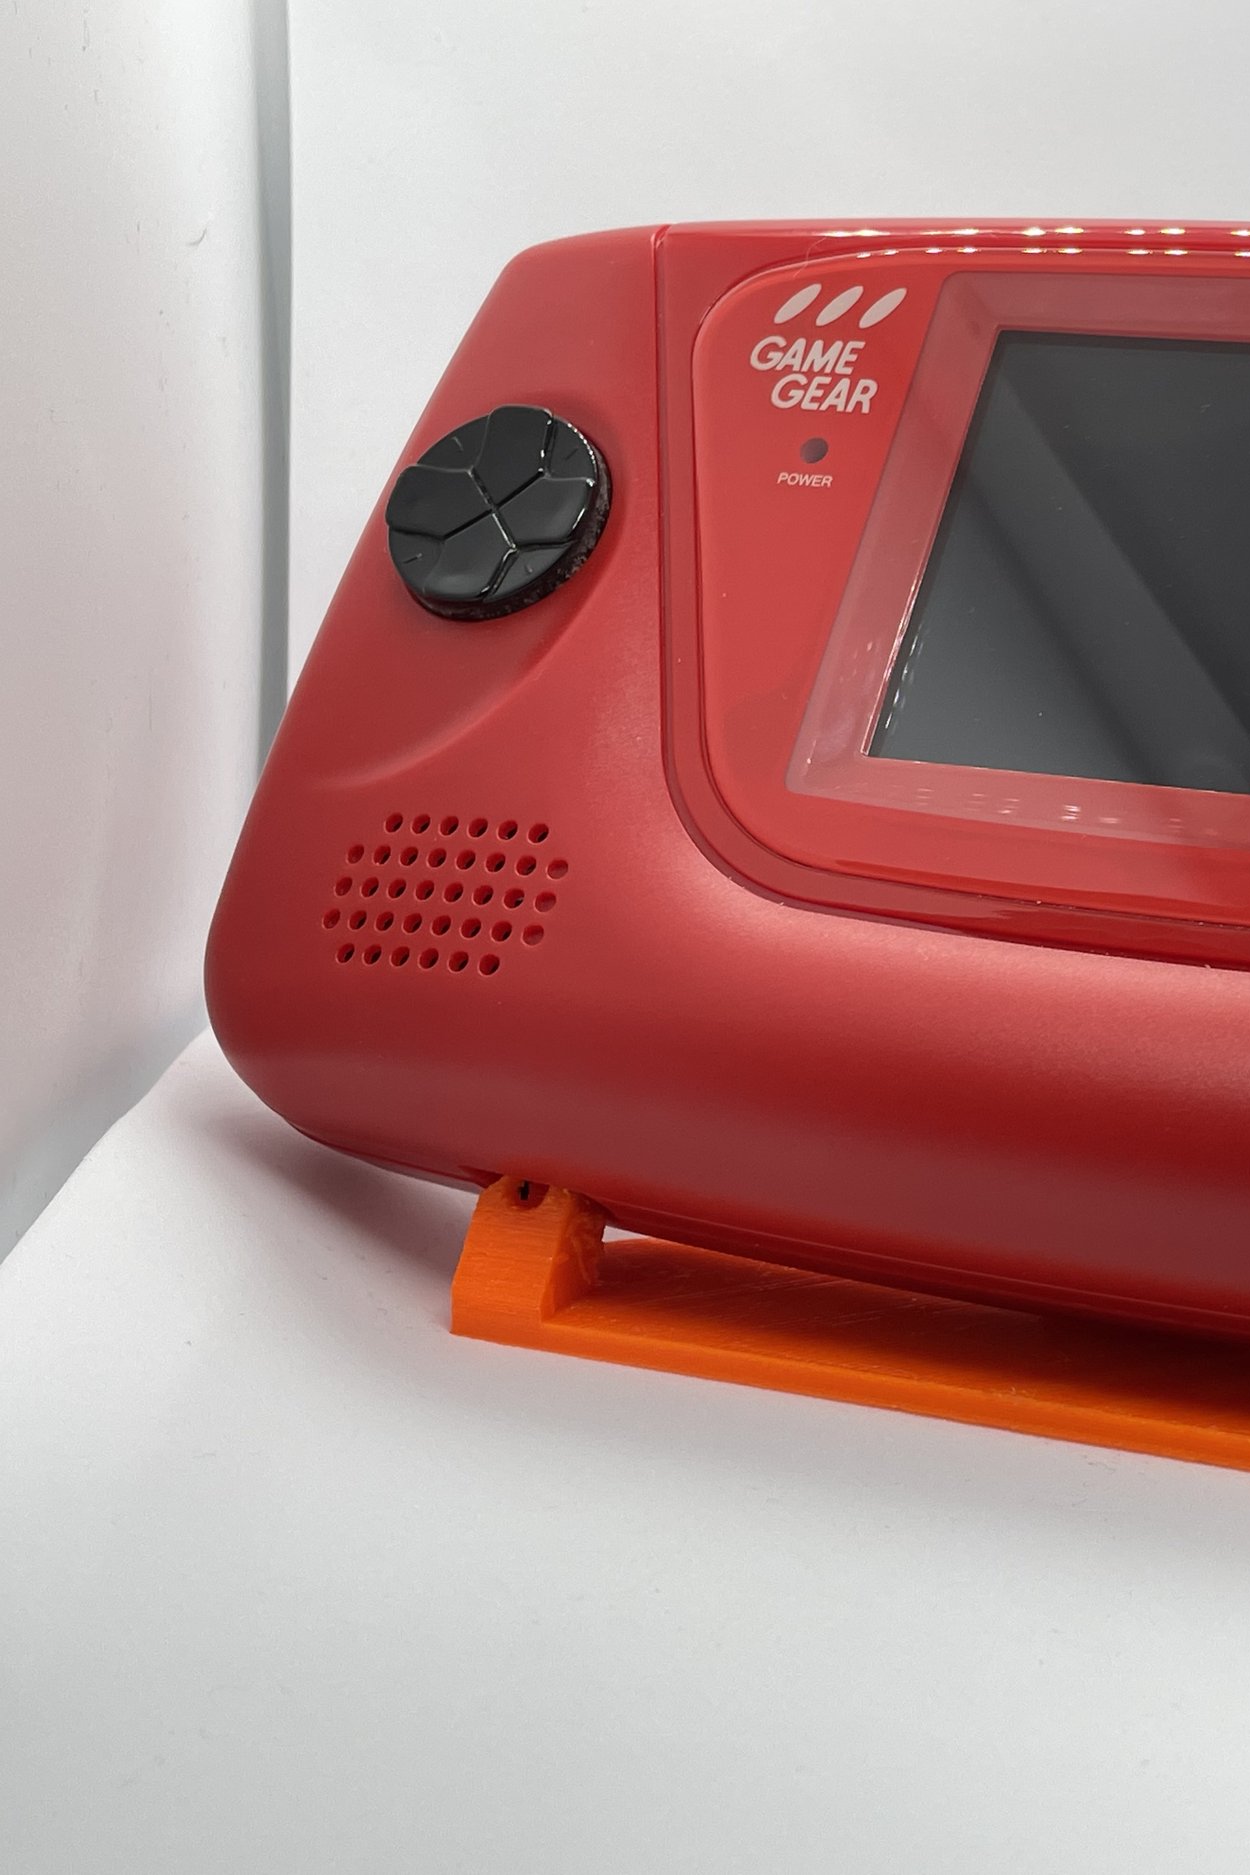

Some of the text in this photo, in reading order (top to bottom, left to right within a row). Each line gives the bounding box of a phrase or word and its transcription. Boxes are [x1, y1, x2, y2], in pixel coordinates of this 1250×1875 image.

[750, 336, 866, 375] GAME
[770, 373, 878, 414] GEAR
[777, 472, 833, 488] POWER
